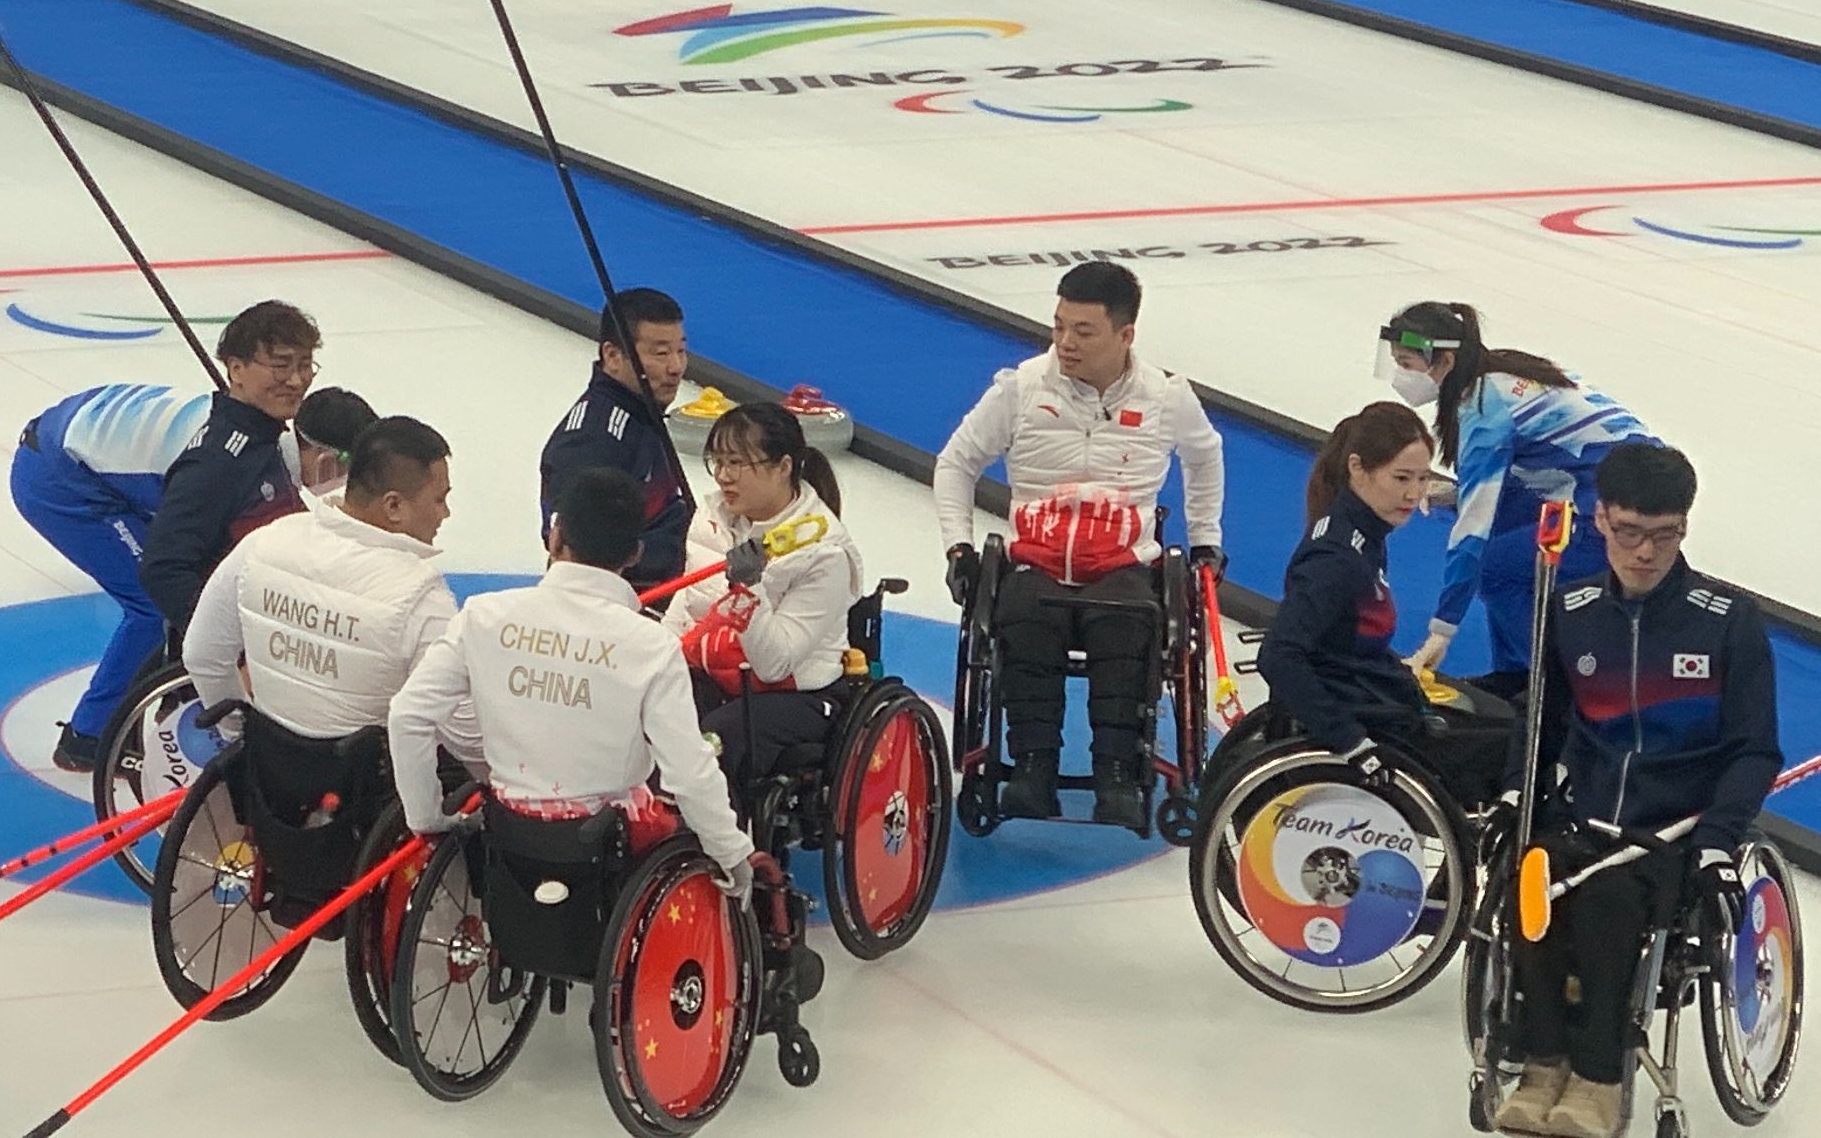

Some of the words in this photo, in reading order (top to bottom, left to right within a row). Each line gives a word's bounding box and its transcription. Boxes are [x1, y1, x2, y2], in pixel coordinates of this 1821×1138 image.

[588, 68, 968, 98] BEIJING
[986, 57, 1268, 81] 2022
[926, 245, 1187, 270] BEIJING
[1197, 236, 1398, 255] 2022
[263, 588, 319, 630] WANG
[323, 609, 360, 643] H.T.
[269, 630, 340, 680] CHINA
[500, 623, 570, 659] CHEN
[574, 638, 618, 670] J.X.
[508, 665, 593, 711] CHINA
[1334, 817, 1414, 855] Korea
